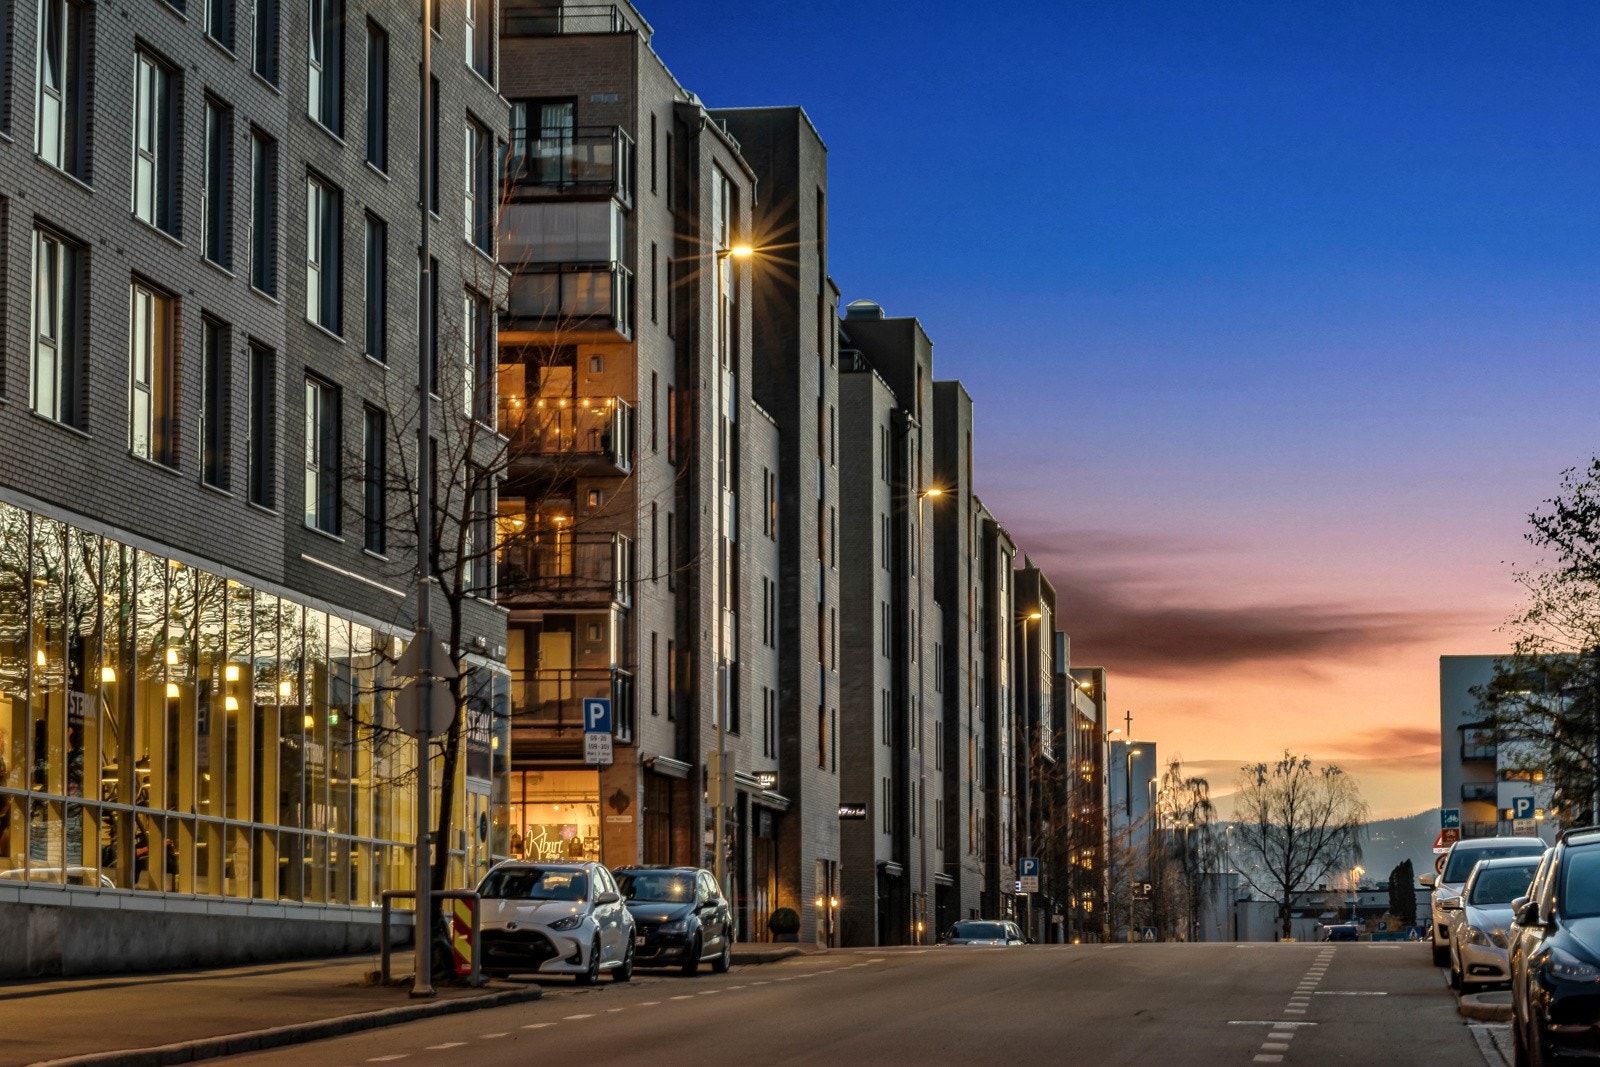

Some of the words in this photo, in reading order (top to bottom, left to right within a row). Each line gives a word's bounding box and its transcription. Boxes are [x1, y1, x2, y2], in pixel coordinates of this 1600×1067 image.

[590, 702, 605, 729] P
[1517, 799, 1530, 817] P
[1024, 860, 1034, 875] P
[1143, 883, 1152, 895] P
